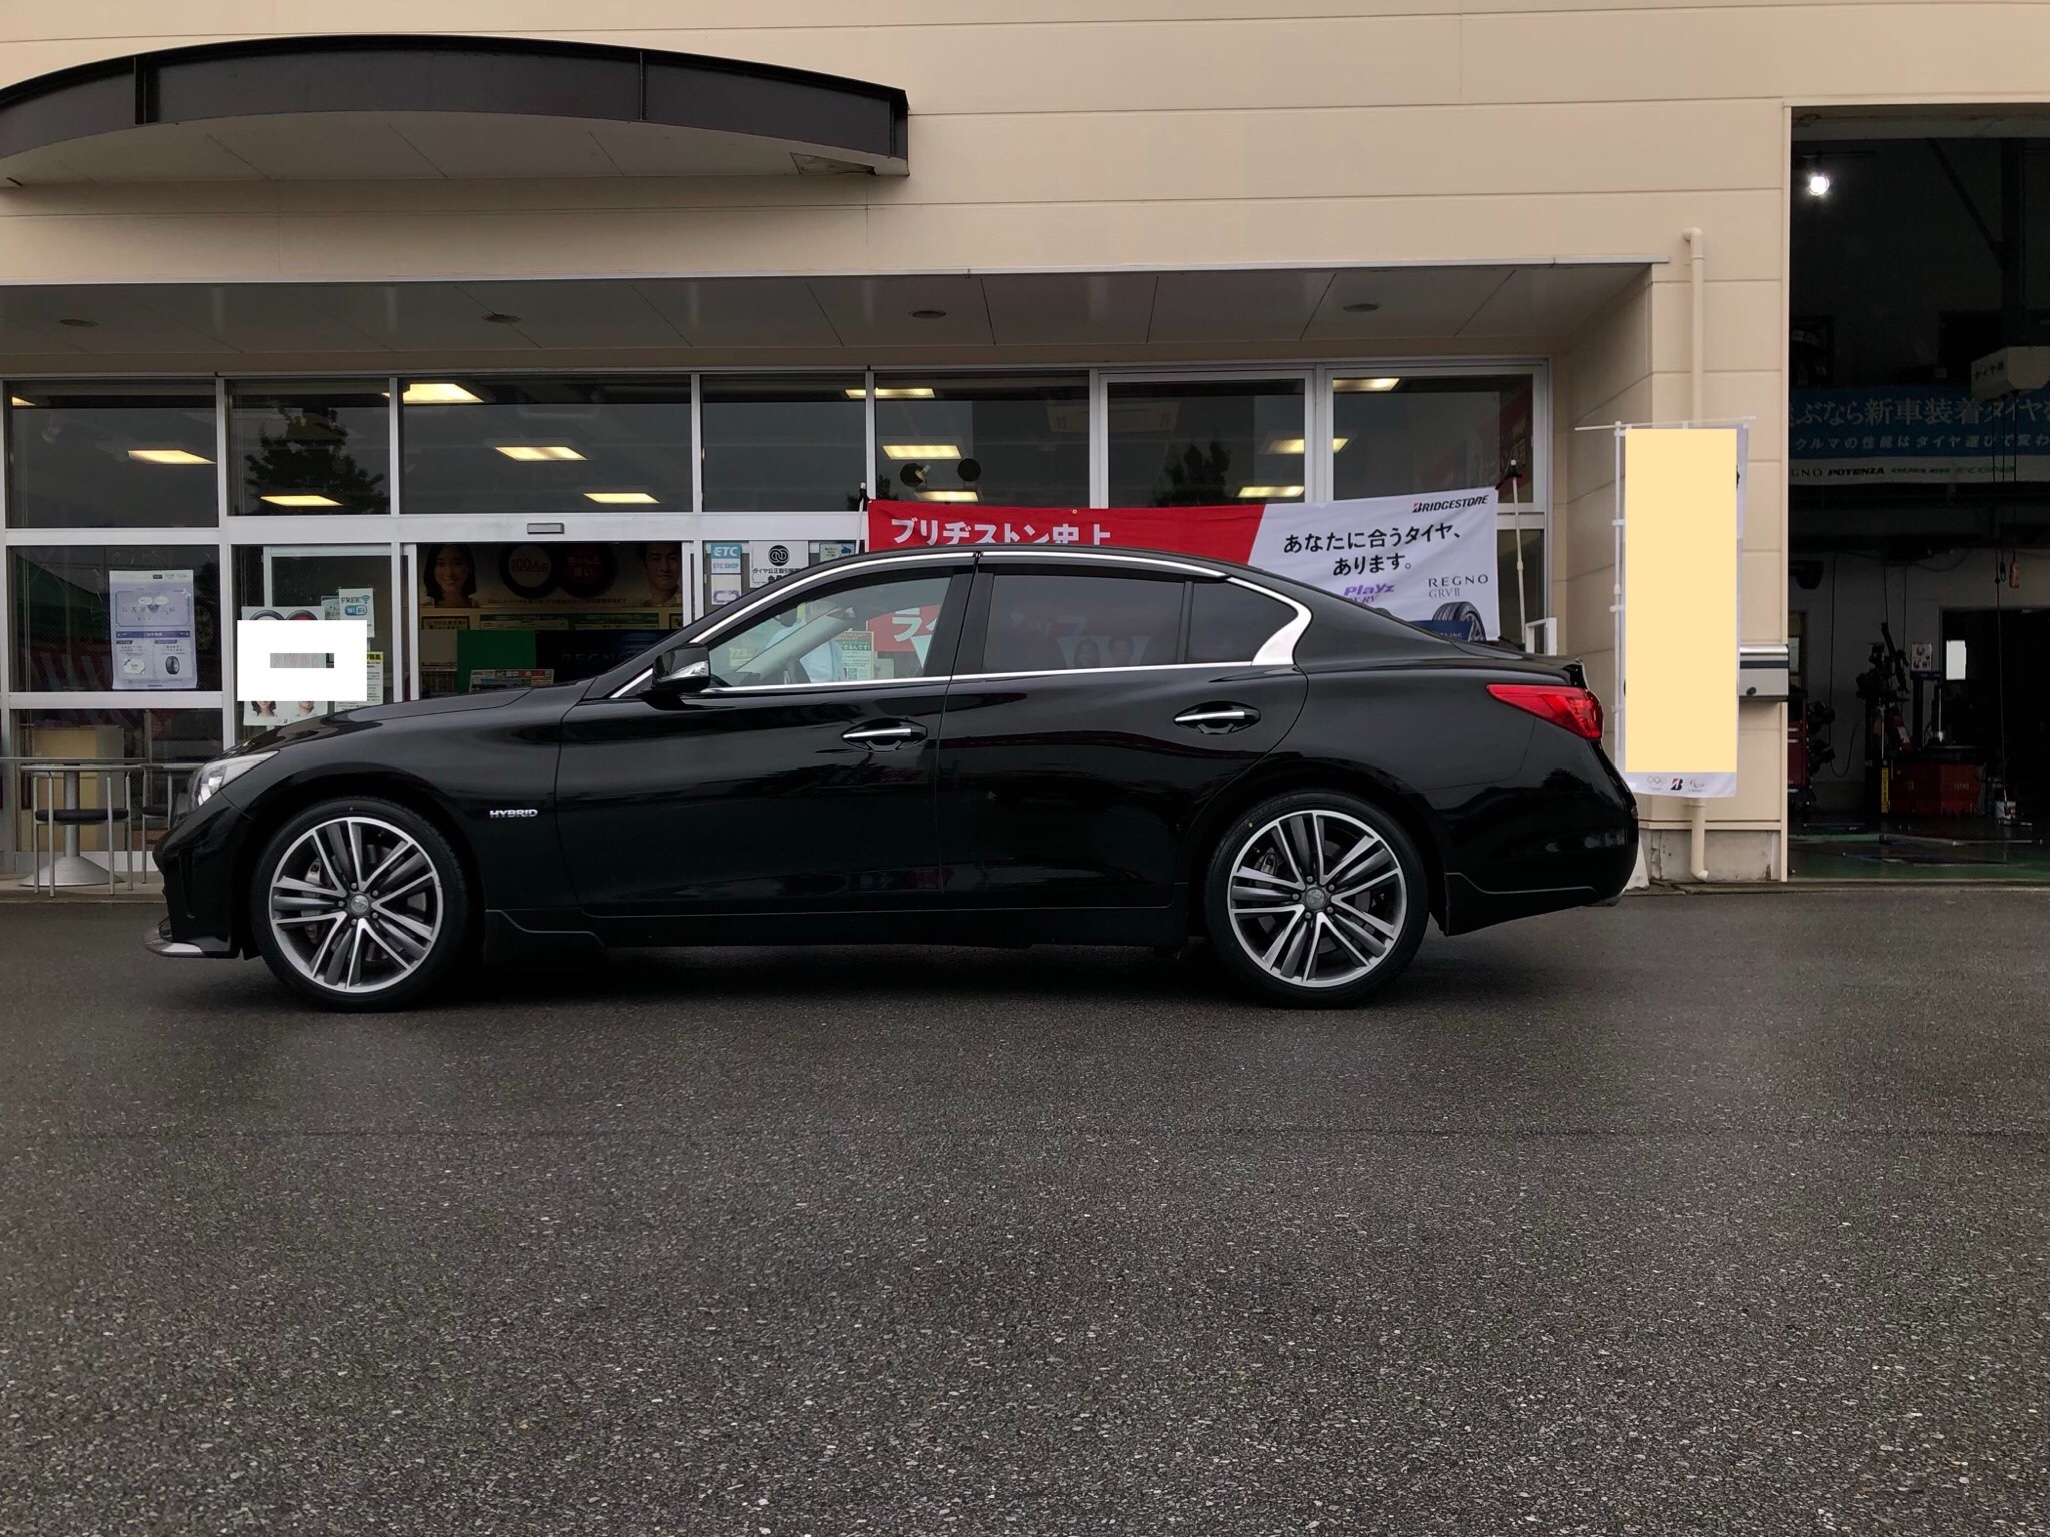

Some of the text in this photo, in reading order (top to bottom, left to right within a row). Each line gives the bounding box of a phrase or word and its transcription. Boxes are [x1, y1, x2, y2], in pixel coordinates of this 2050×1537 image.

[1413, 495, 1489, 513] BRIDGESTONE
[1284, 522, 1461, 553] あなたに合うタイヤ、
[713, 546, 739, 557] ETC
[1333, 552, 1412, 576] あります。
[1428, 573, 1489, 588] REGNO
[1343, 583, 1396, 596] Playz
[341, 596, 362, 604] FREE
[489, 808, 539, 818] HYBRID
